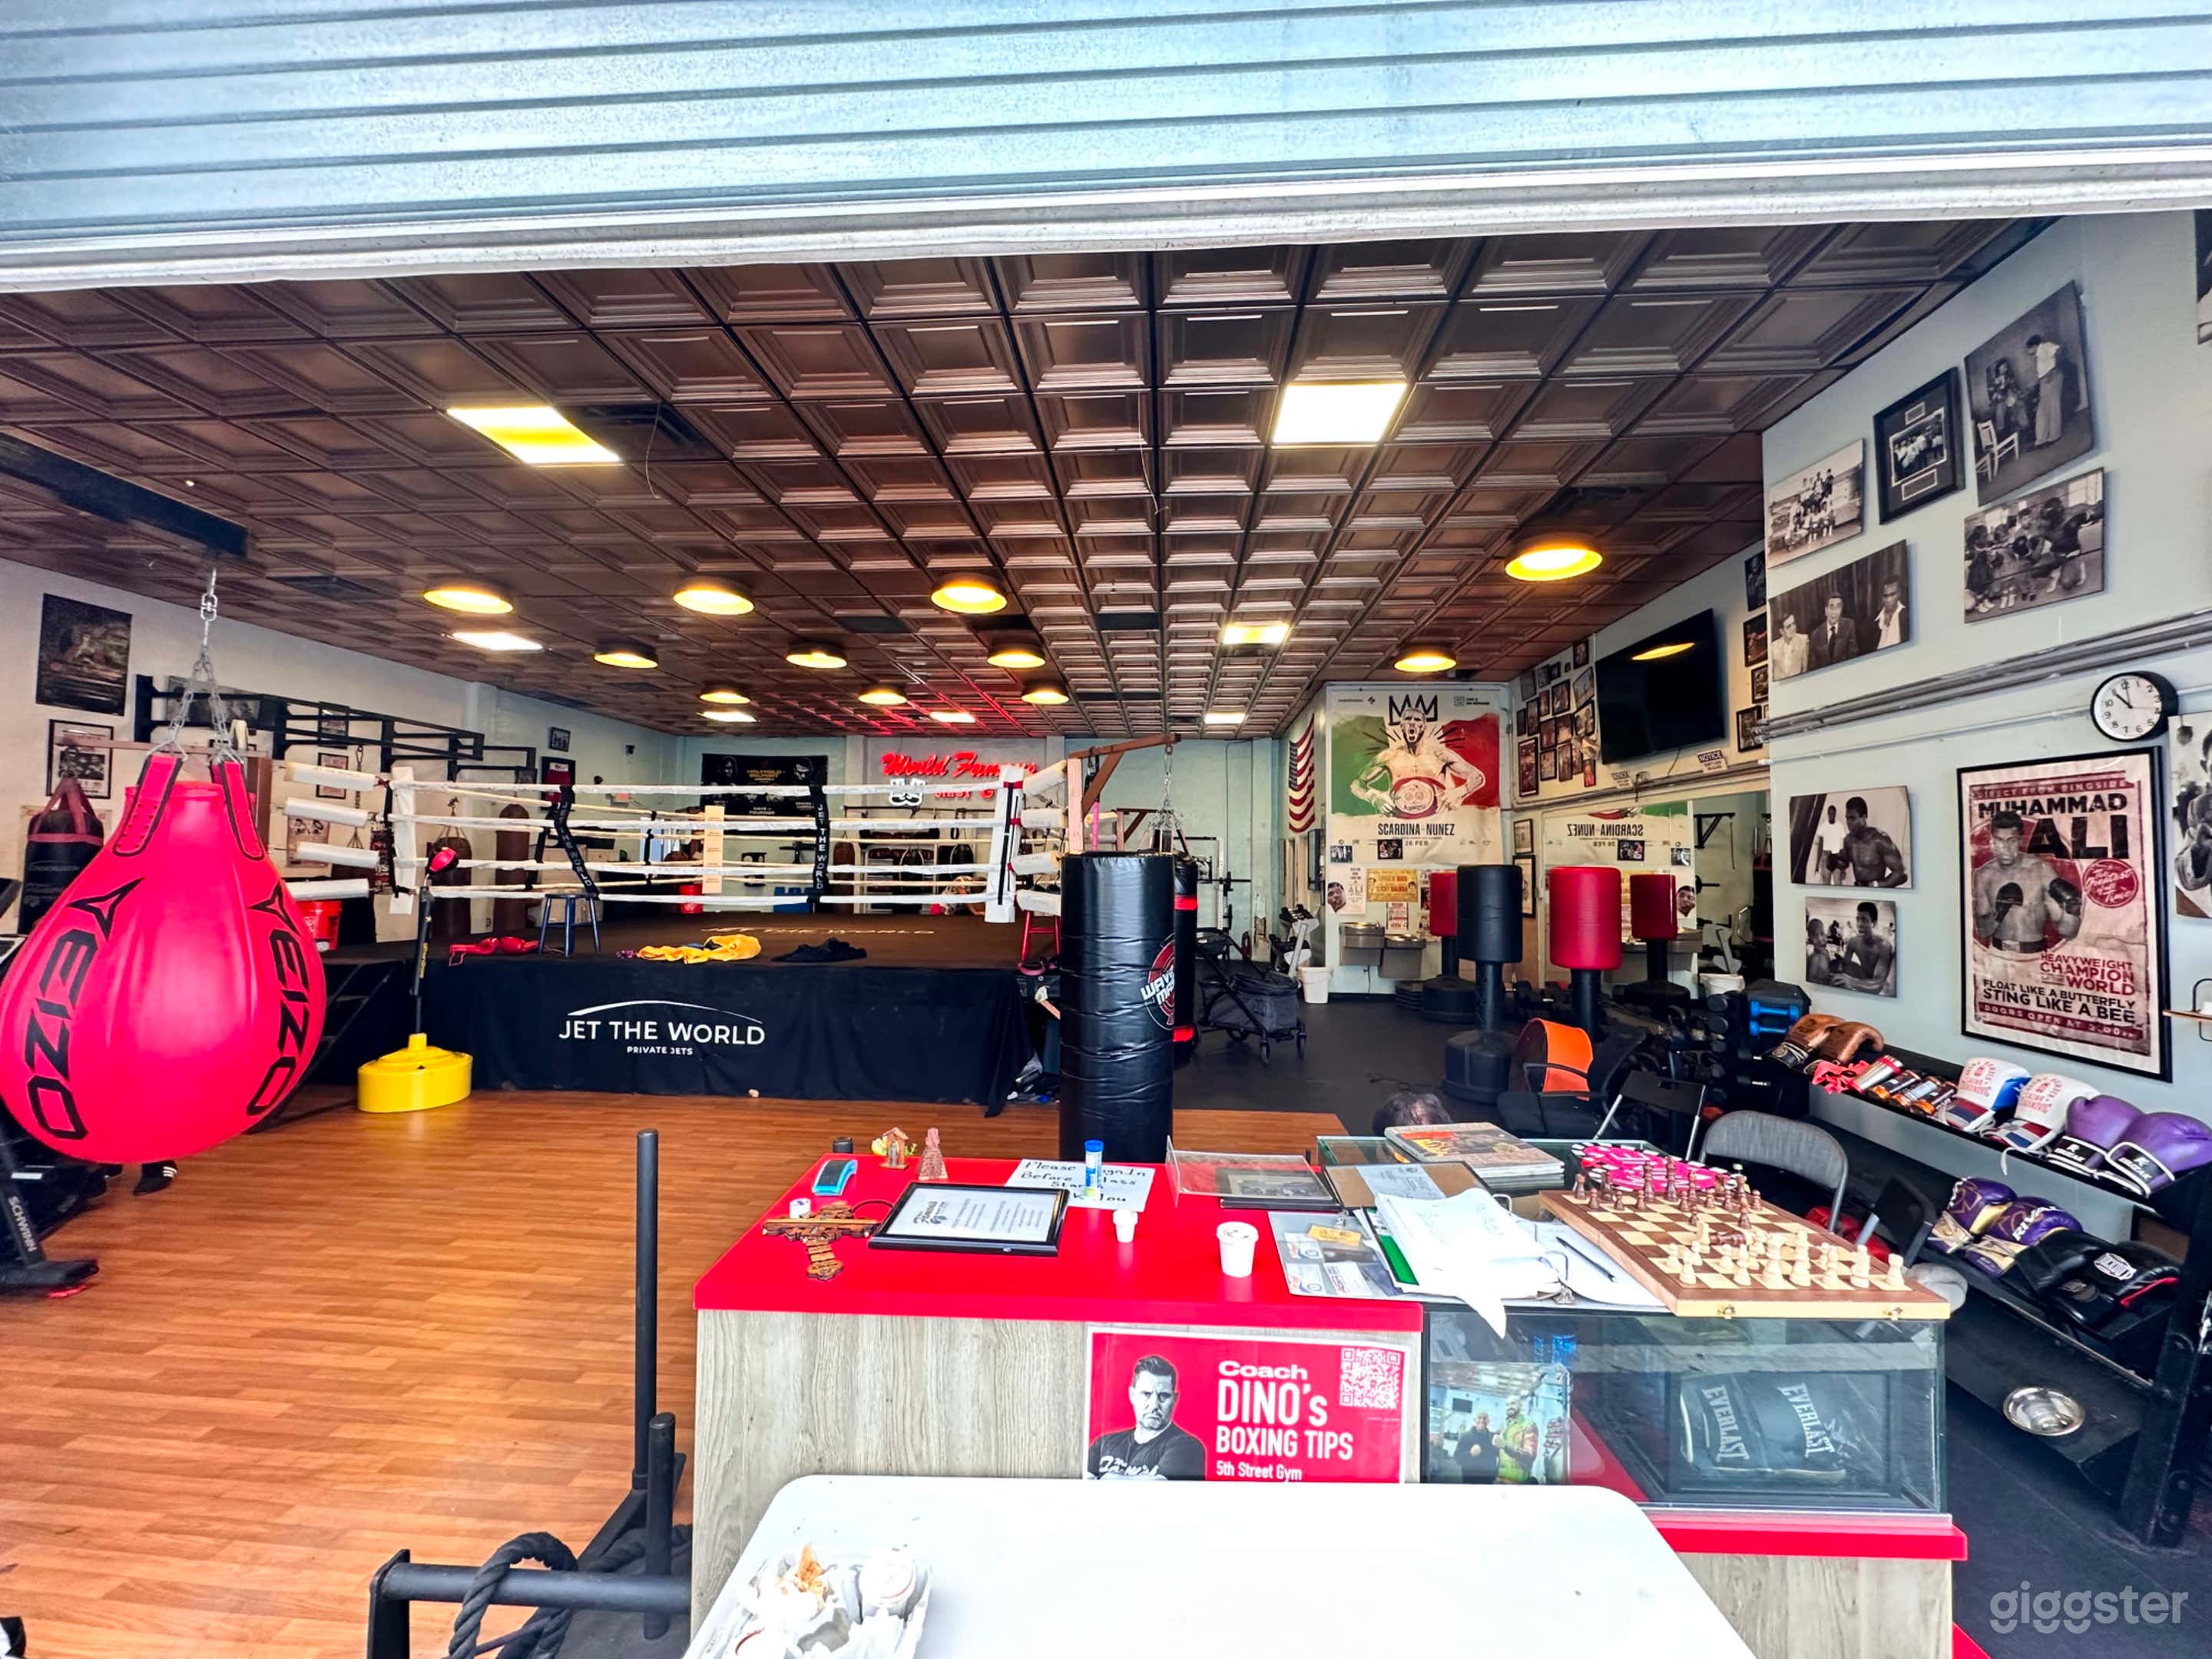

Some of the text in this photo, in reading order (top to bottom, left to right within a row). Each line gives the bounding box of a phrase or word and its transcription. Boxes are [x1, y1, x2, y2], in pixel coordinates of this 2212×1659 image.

[881, 750, 1038, 778] World Fams
[1699, 750, 1724, 763] NOTICE
[2061, 779, 2128, 793] RINGSIDE
[1979, 793, 2128, 818] MUHAMMAD
[818, 828, 827, 852] THE
[1377, 823, 1455, 836] SCARDINA NUNEZ
[2027, 815, 2129, 859] ALI
[816, 854, 827, 889] WORLD
[2040, 962, 2134, 982] CHAMPION
[2041, 952, 2133, 970] HEAVYWEIGHT
[1983, 979, 2135, 1009] FLOAT LIKE A BUTTERFLY
[2066, 975, 2135, 995] WORLD
[1983, 988, 2135, 1024] STING LIKE A BEE
[558, 1020, 766, 1045] JET THE WORLD
[2028, 1012, 2061, 1026] OPEN
[2065, 1020, 2082, 1029] AT
[627, 1046, 693, 1055] PRIVATE JETS
[1025, 1161, 1077, 1171] Please
[1021, 1171, 1137, 1186] Before lass
[8, 1196, 37, 1253] SCHWINN
[1218, 1360, 1308, 1380] Coach
[1217, 1379, 1328, 1427] DINO's
[1701, 1385, 1750, 1462] EVERLAST
[1777, 1382, 1836, 1459] EVERLAST
[1216, 1426, 1354, 1461] BOXING TIPS
[1216, 1459, 1303, 1482] 5th Street Gym
